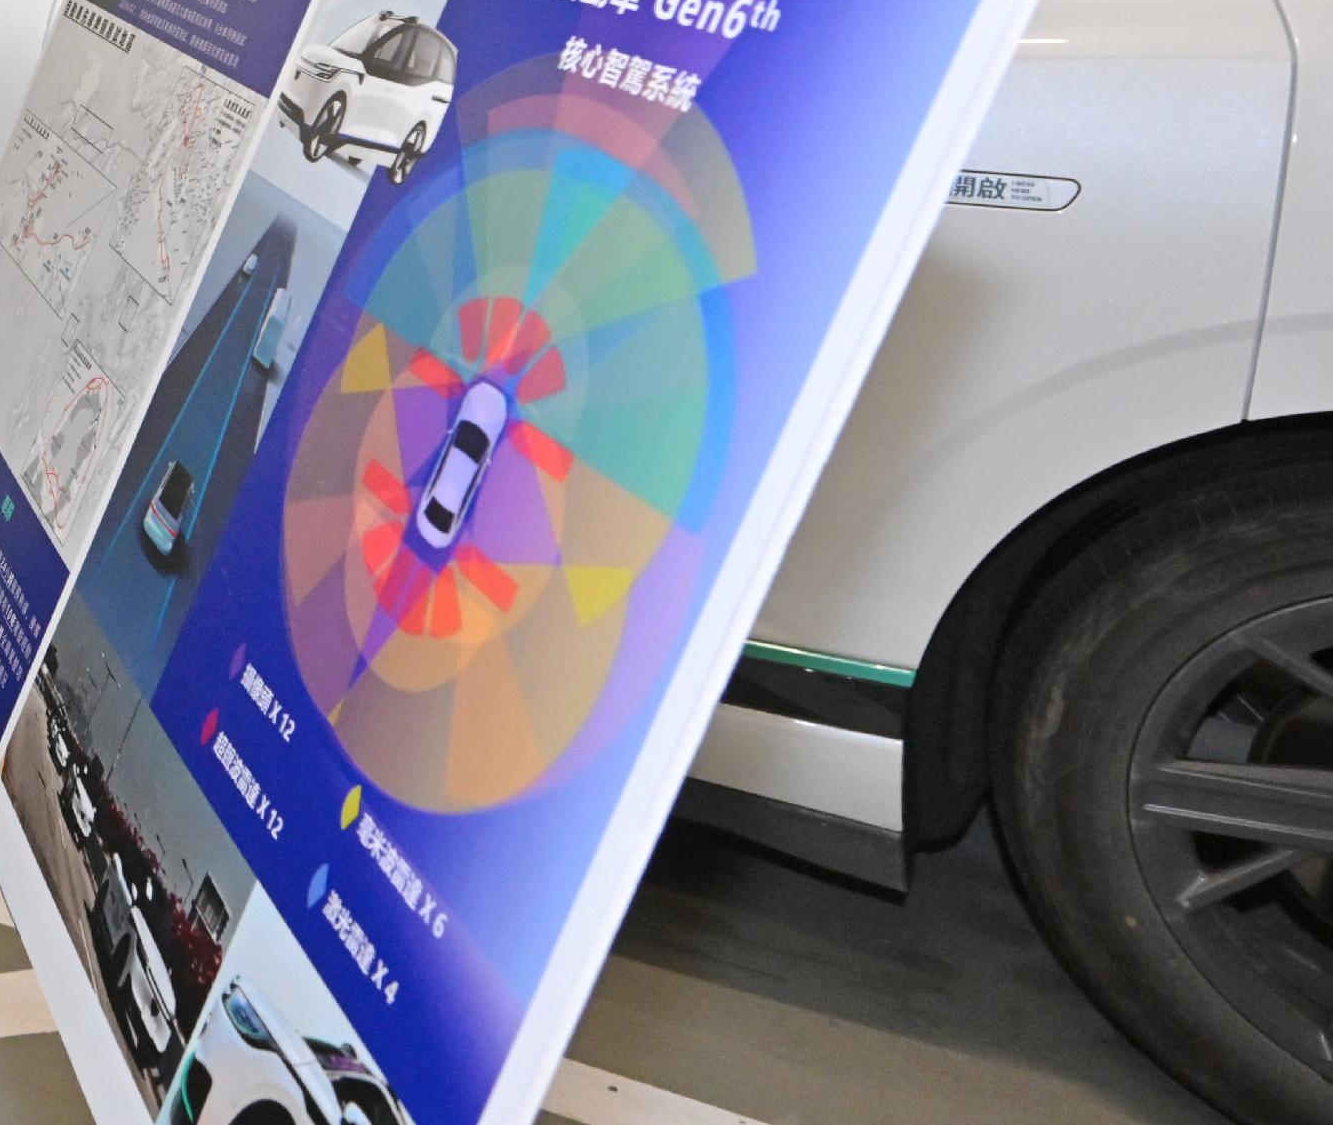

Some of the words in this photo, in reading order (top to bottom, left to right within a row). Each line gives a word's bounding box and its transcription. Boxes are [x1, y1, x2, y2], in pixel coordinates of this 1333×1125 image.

[557, 35, 702, 113] 核心智駕系統
[279, 713, 295, 742] 12
[267, 809, 284, 841] 12
[432, 913, 448, 939] 6
[384, 981, 400, 1005] 4
